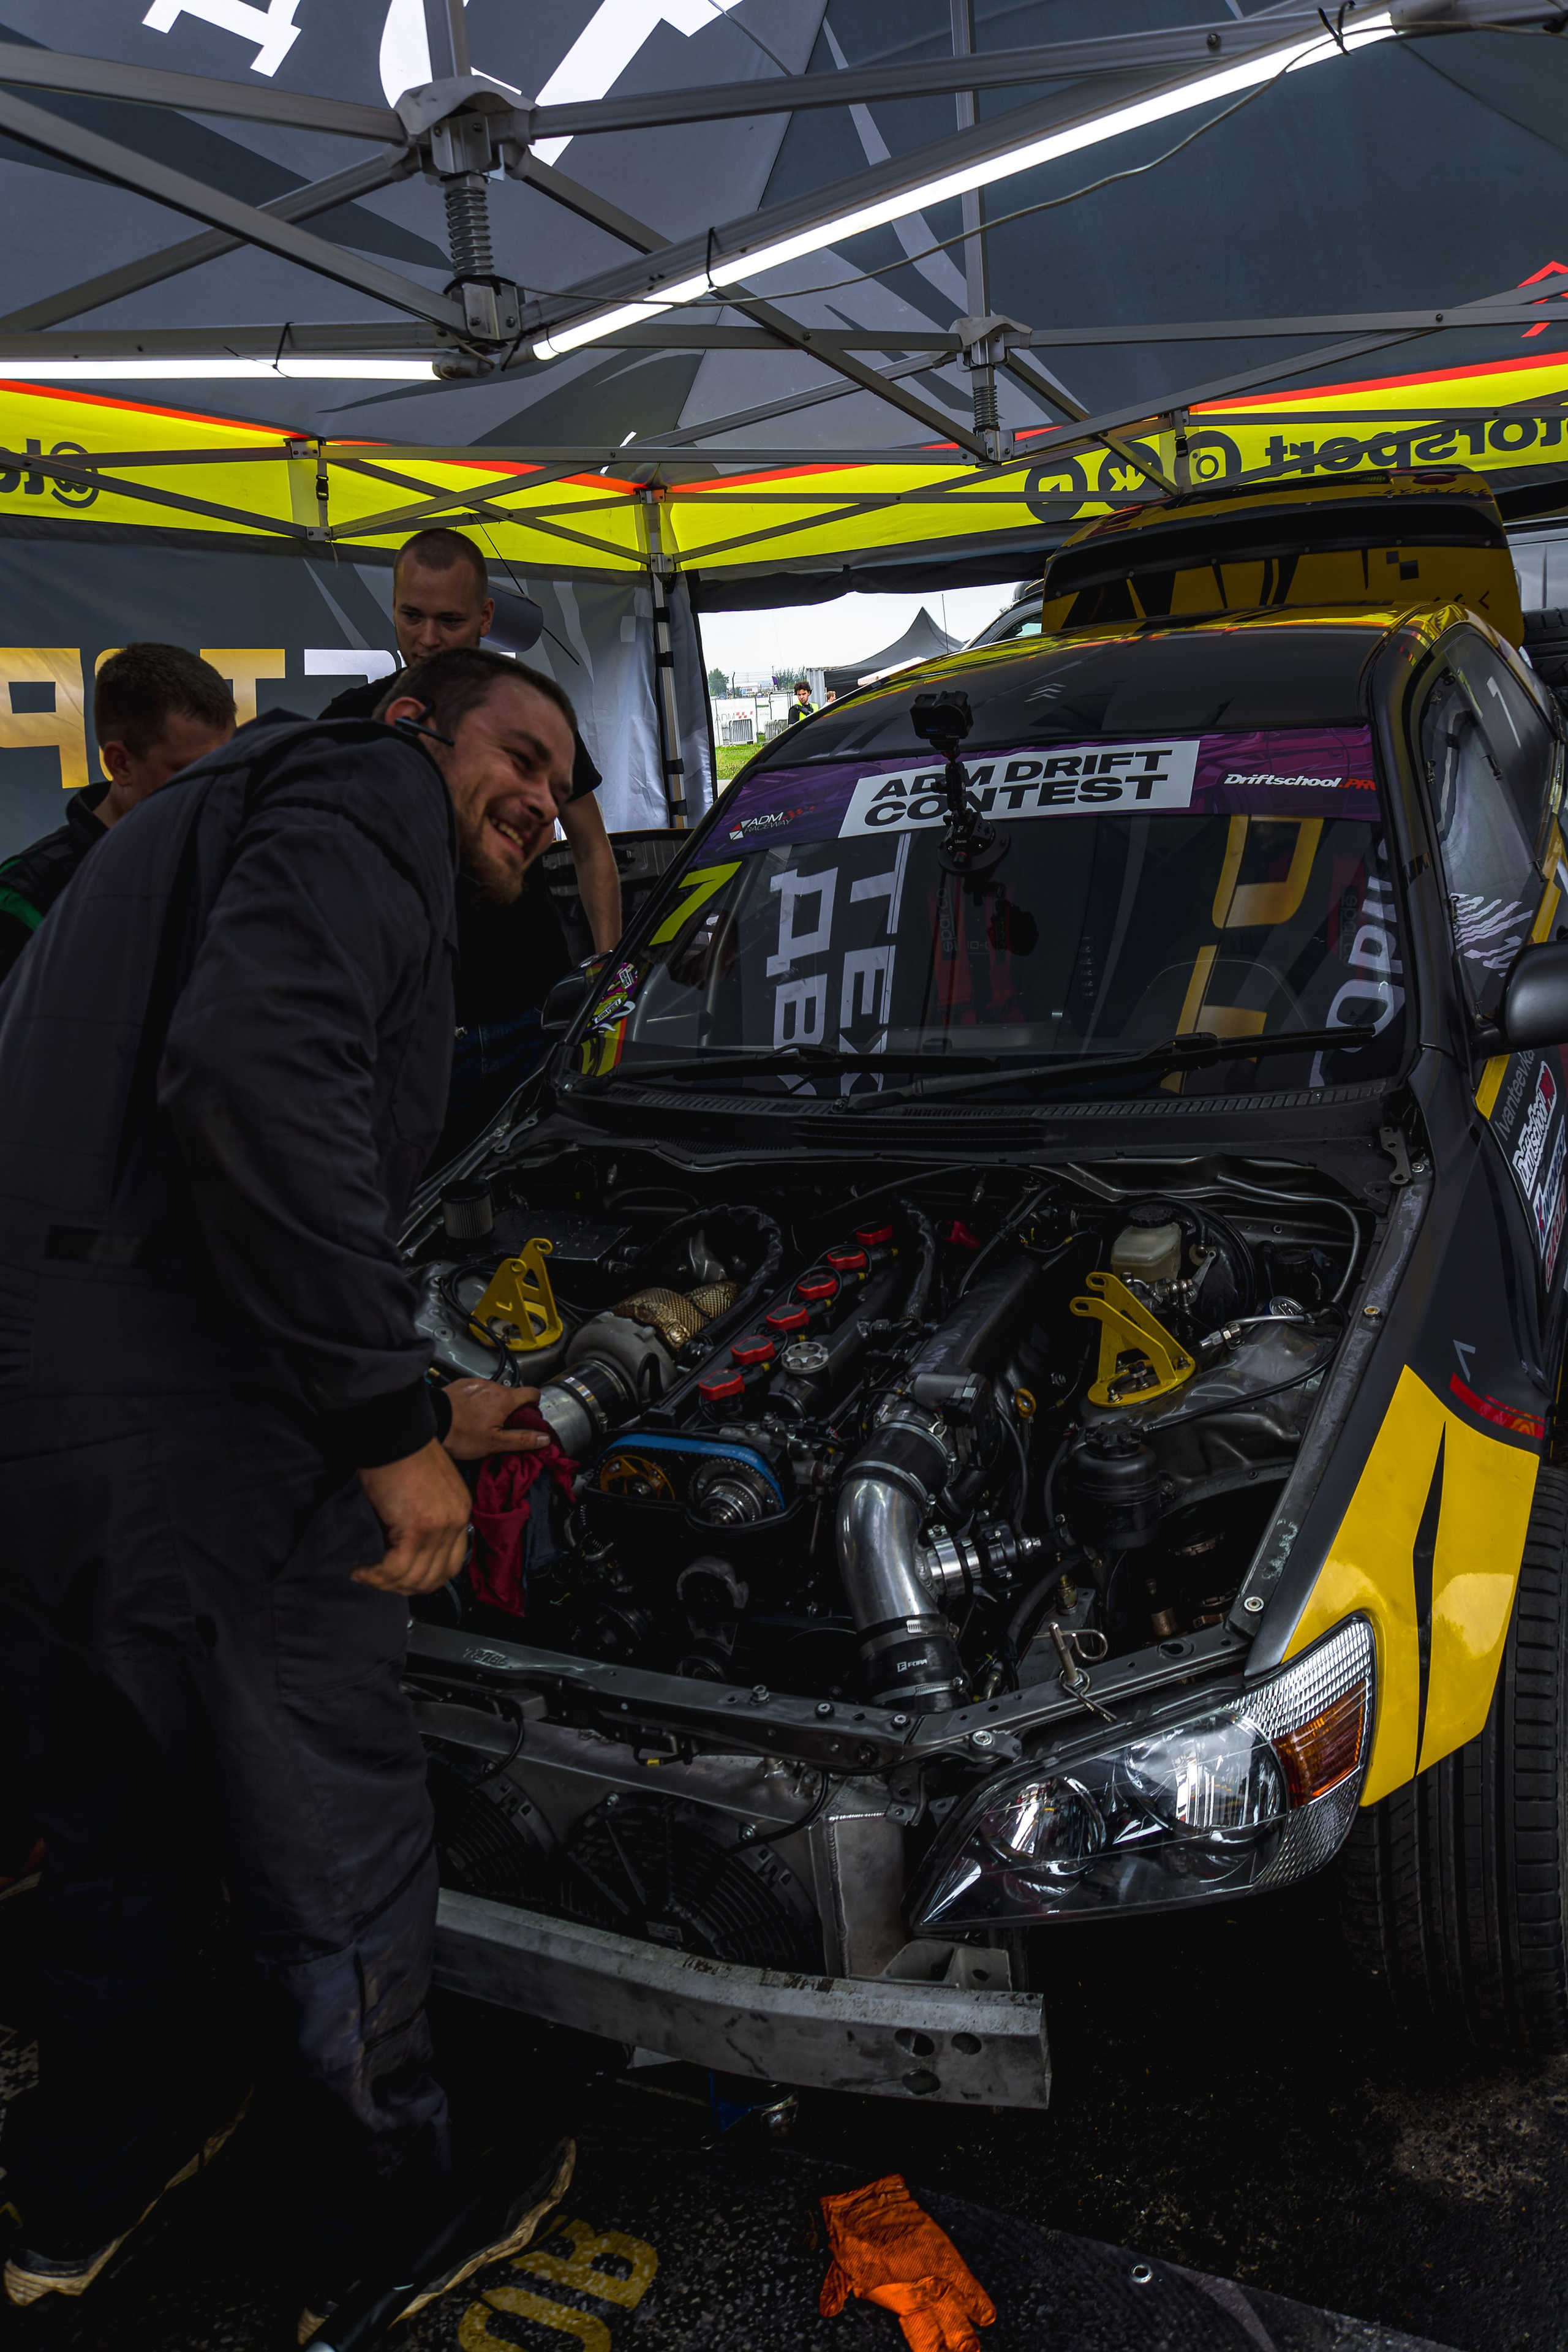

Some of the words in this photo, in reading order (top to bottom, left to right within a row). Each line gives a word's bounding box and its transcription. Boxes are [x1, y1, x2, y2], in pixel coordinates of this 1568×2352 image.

[870, 764, 995, 802] ADM
[1004, 750, 1172, 783] DRIFT
[747, 805, 784, 827] ADM
[864, 774, 1169, 827] CONTEST
[744, 818, 793, 834] RACEWAY
